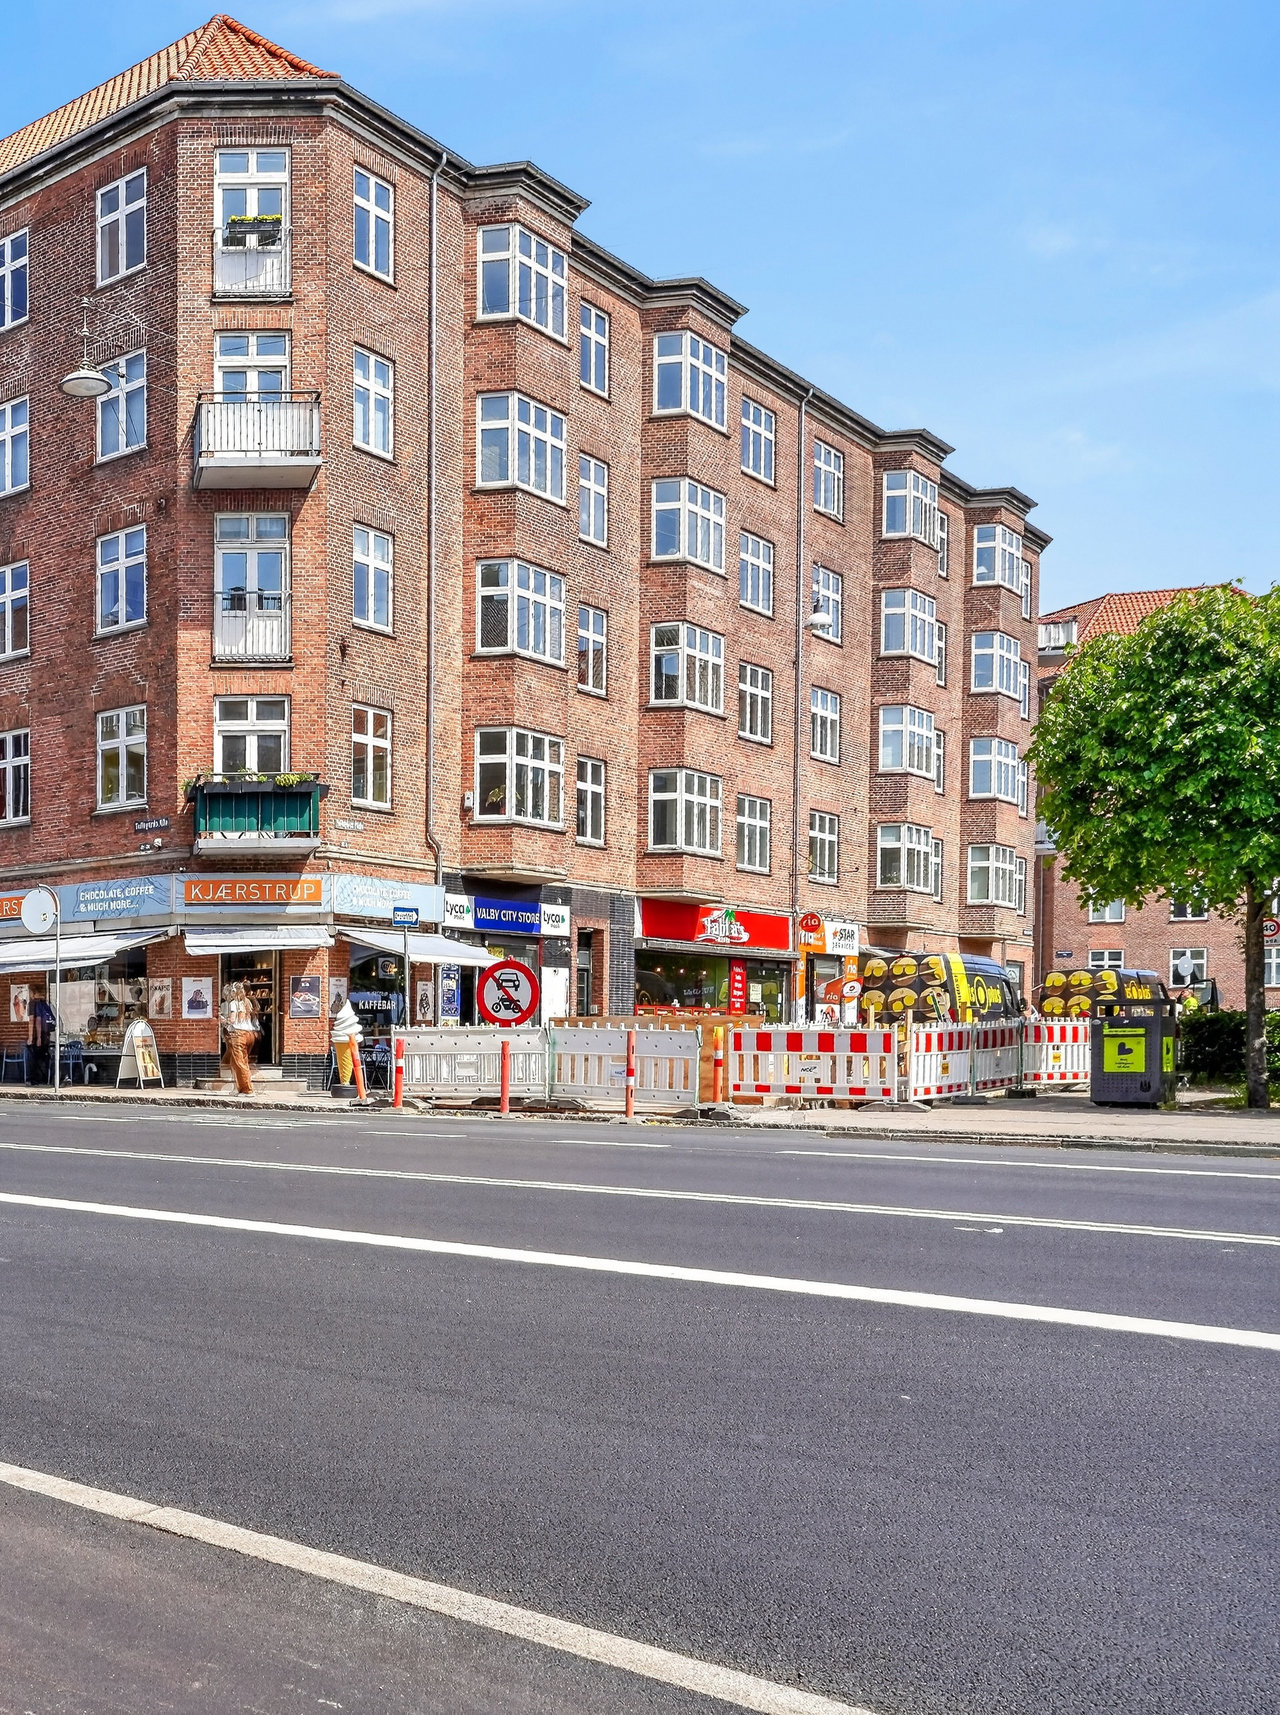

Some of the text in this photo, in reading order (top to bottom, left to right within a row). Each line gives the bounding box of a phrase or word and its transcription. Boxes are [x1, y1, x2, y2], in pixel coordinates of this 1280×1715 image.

[80, 885, 154, 900] CHOCOLATE, COFFEE
[191, 883, 315, 900] KJÆRSTRUP
[80, 903, 87, 912] &
[87, 901, 110, 912] MUCH
[445, 901, 465, 914] Lyca
[476, 907, 540, 924] VALBY CITY STORE
[543, 910, 561, 924] Lyca
[802, 916, 819, 926] ria
[838, 928, 856, 941] STAR
[826, 992, 839, 1000] ria
[358, 1000, 396, 1010] KAFFEBAR
